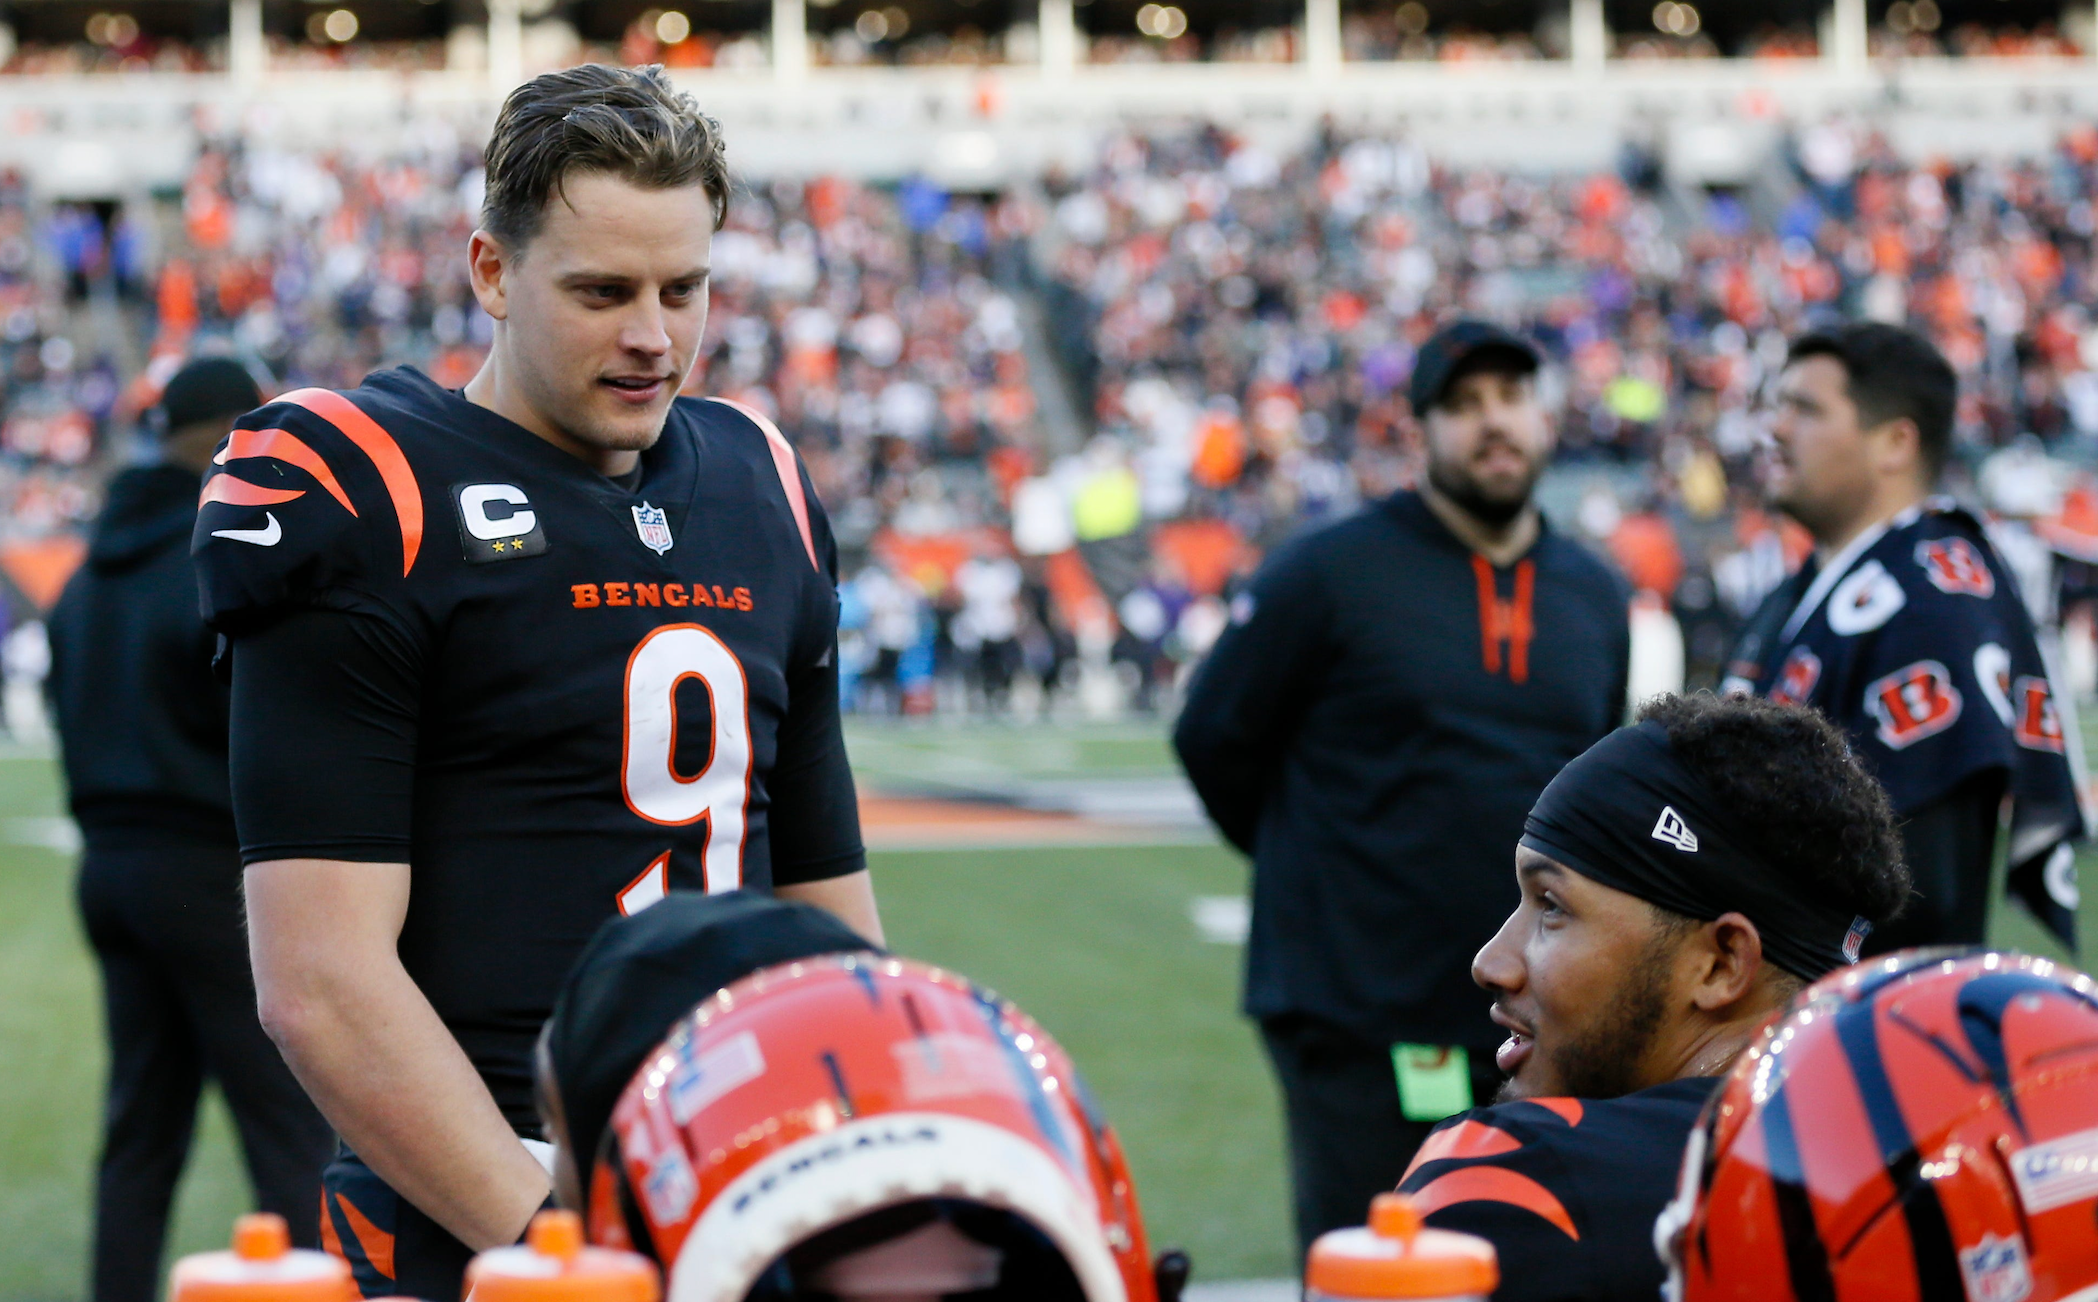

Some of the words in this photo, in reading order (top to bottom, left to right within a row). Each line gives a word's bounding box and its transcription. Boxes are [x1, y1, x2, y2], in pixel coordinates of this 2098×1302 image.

[460, 484, 536, 540] C
[570, 582, 754, 612] BENGALS
[1863, 659, 1964, 751] B
[615, 622, 754, 917] 9
